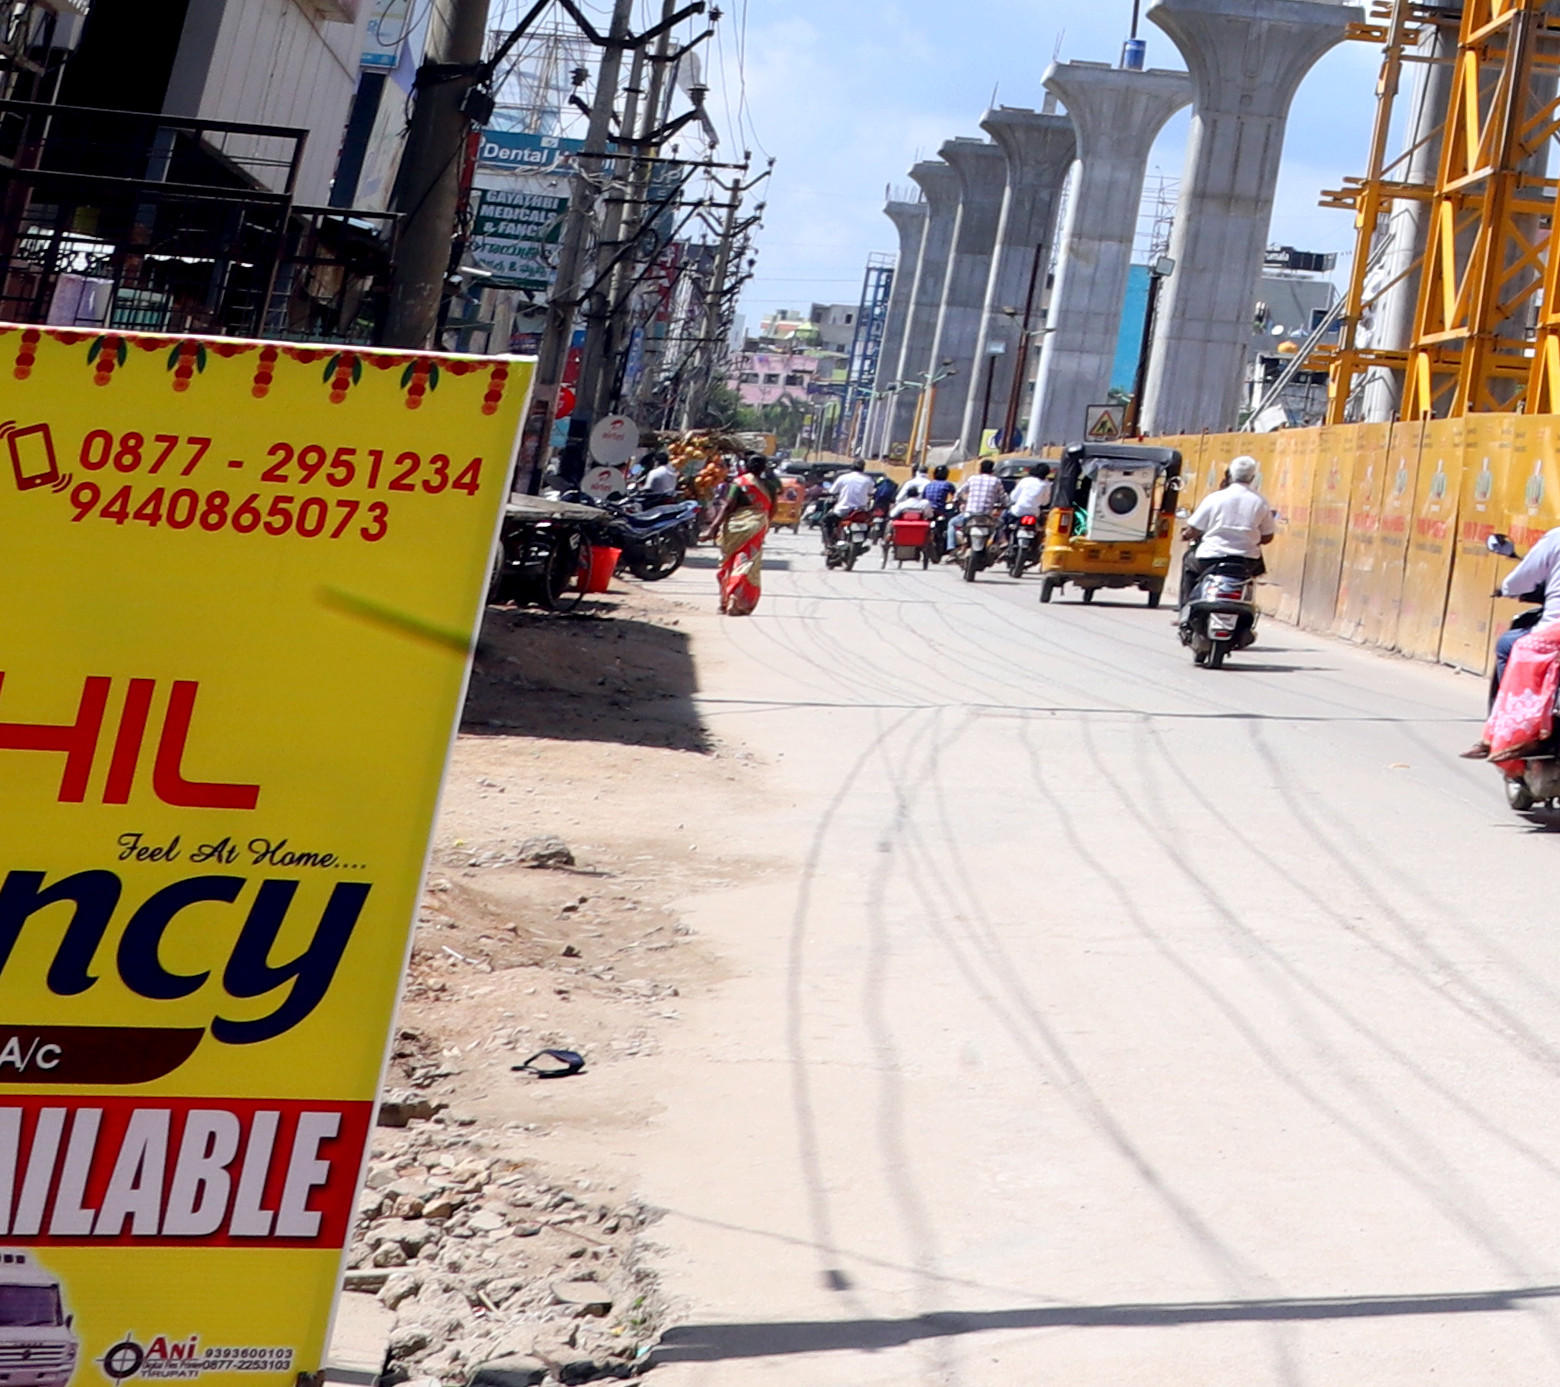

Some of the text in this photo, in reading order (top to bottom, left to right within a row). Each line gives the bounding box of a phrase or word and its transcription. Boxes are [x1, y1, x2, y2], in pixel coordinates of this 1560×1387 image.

[483, 142, 548, 163] Dental
[480, 204, 558, 224] MEDICALS
[79, 429, 484, 497] 0877 - 2951234
[69, 481, 390, 543] 9440865073
[117, 832, 181, 863] Feel
[190, 836, 239, 865] At
[0, 869, 373, 1045] ncy
[202, 1360, 291, 1371] 0877-2253103
[205, 1348, 293, 1359] 9393600103
